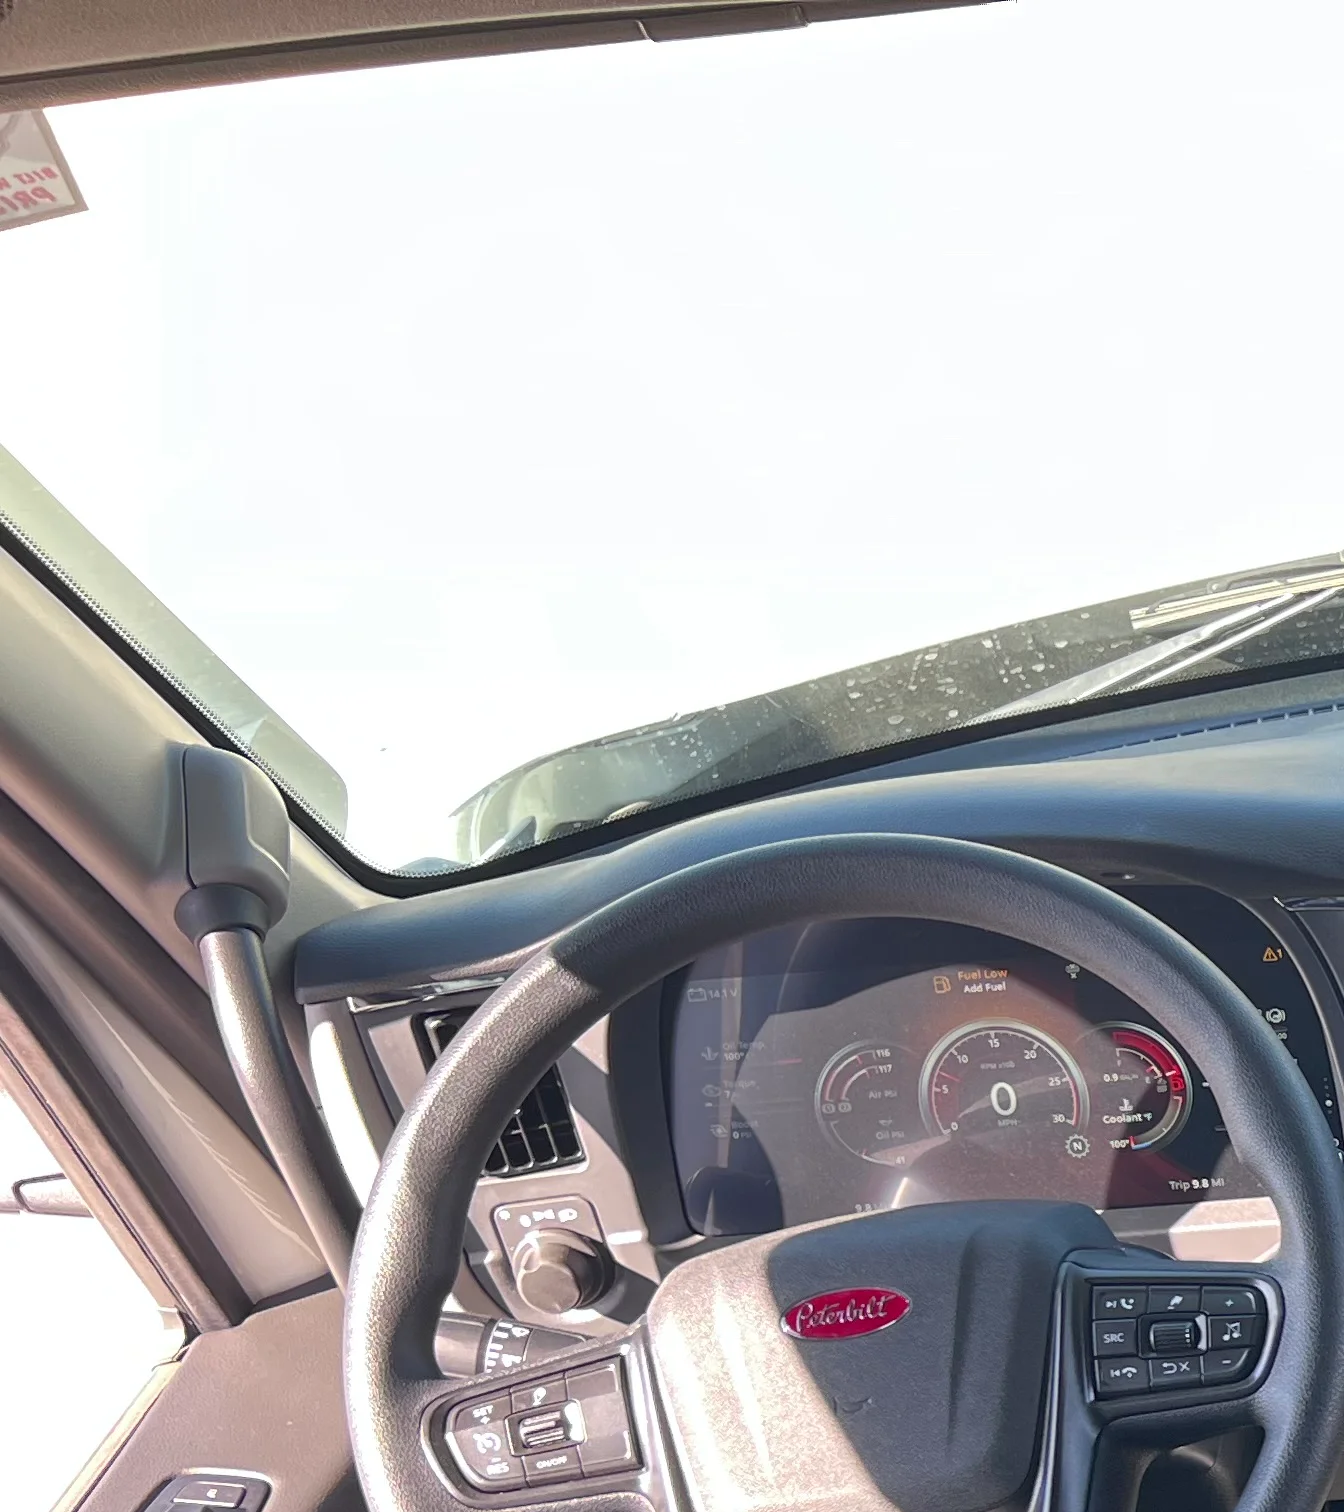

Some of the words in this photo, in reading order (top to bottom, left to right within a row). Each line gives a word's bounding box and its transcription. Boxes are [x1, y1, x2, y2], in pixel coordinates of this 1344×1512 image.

[957, 970, 982, 981] Fuel
[984, 968, 1009, 980] Low
[963, 983, 983, 994] Add
[985, 981, 1006, 993] Fuel
[988, 1039, 1000, 1048] 15
[957, 1054, 969, 1064] 10
[1024, 1050, 1037, 1060] 20
[1048, 1076, 1061, 1086] 25
[1103, 1073, 1119, 1083] 0.9
[941, 1085, 949, 1094] 5
[990, 1081, 1017, 1116] 0
[1053, 1114, 1066, 1123] 30
[1102, 1112, 1142, 1124] Coolant
[951, 1122, 958, 1131] 0
[1072, 1141, 1083, 1151] N
[1169, 1180, 1191, 1192] Trip
[1192, 1178, 1210, 1189] 9.8
[796, 1295, 897, 1332] Peterbilt
[1103, 1332, 1125, 1344] SRC
